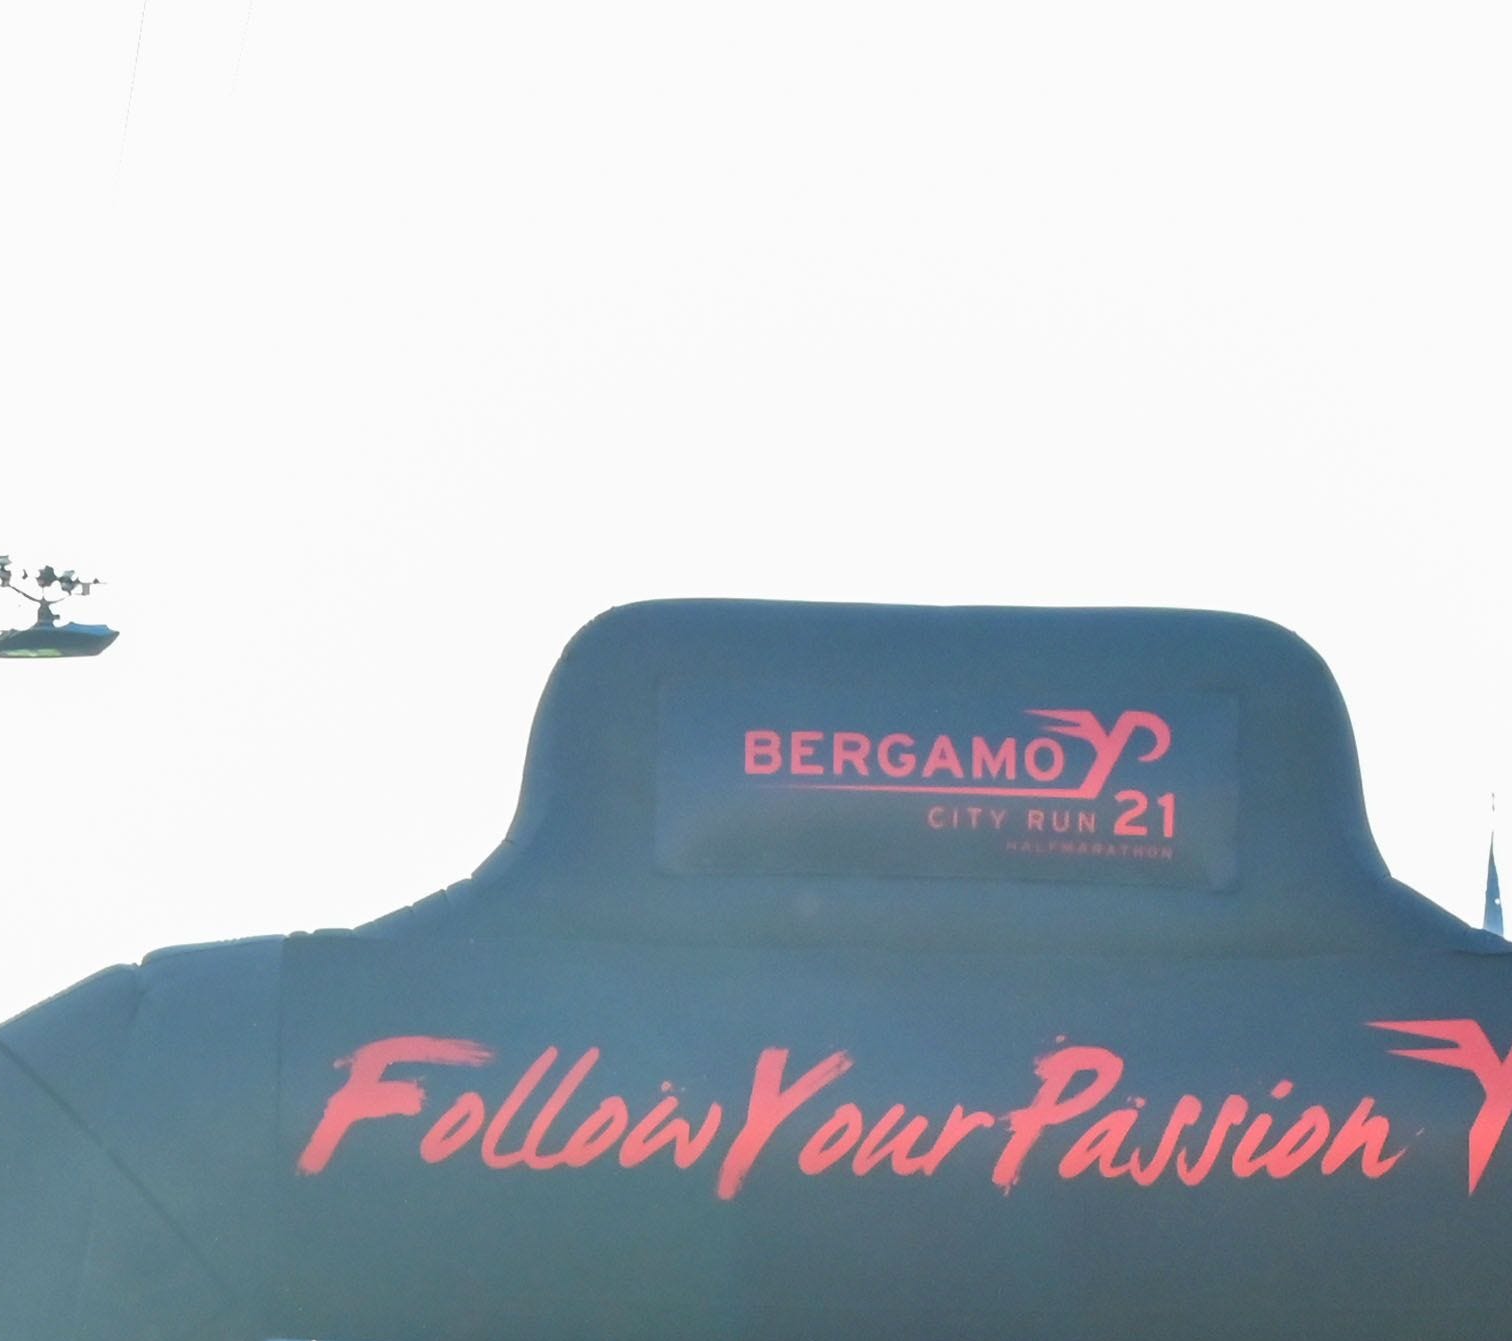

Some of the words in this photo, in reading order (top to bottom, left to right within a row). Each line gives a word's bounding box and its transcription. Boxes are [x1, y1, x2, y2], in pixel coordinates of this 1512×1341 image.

[744, 730, 1065, 781] BERGAMO
[927, 805, 1007, 831] CITY
[1027, 808, 1097, 833] RUN
[1114, 790, 1177, 838] 21
